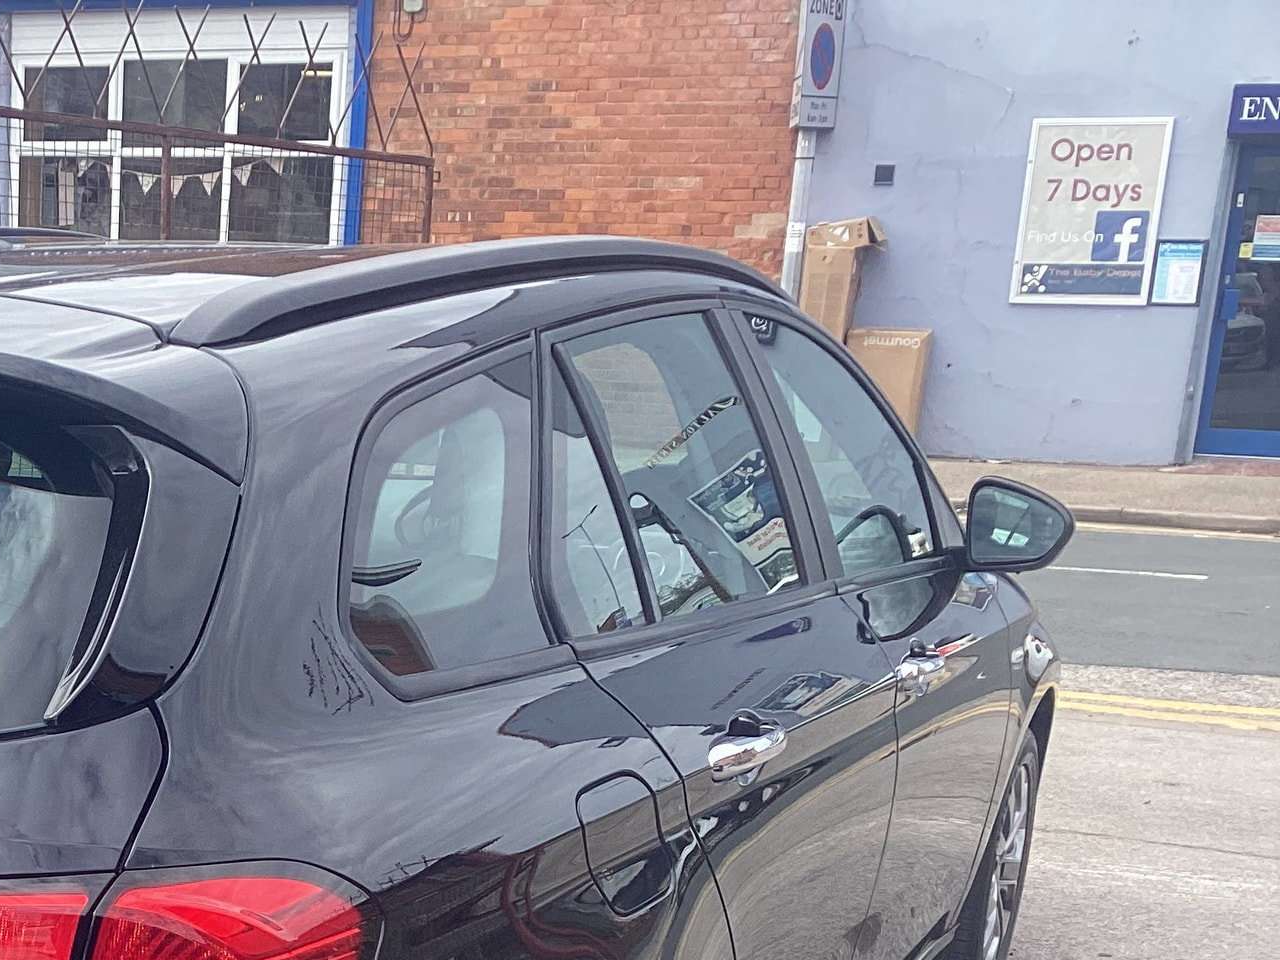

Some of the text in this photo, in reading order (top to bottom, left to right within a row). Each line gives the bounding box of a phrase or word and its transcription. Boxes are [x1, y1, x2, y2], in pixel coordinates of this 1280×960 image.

[1051, 138, 1133, 167] Open
[1047, 178, 1143, 208] 7 Days
[1027, 230, 1104, 243] Find Us On
[864, 335, 921, 349] Gourmet
